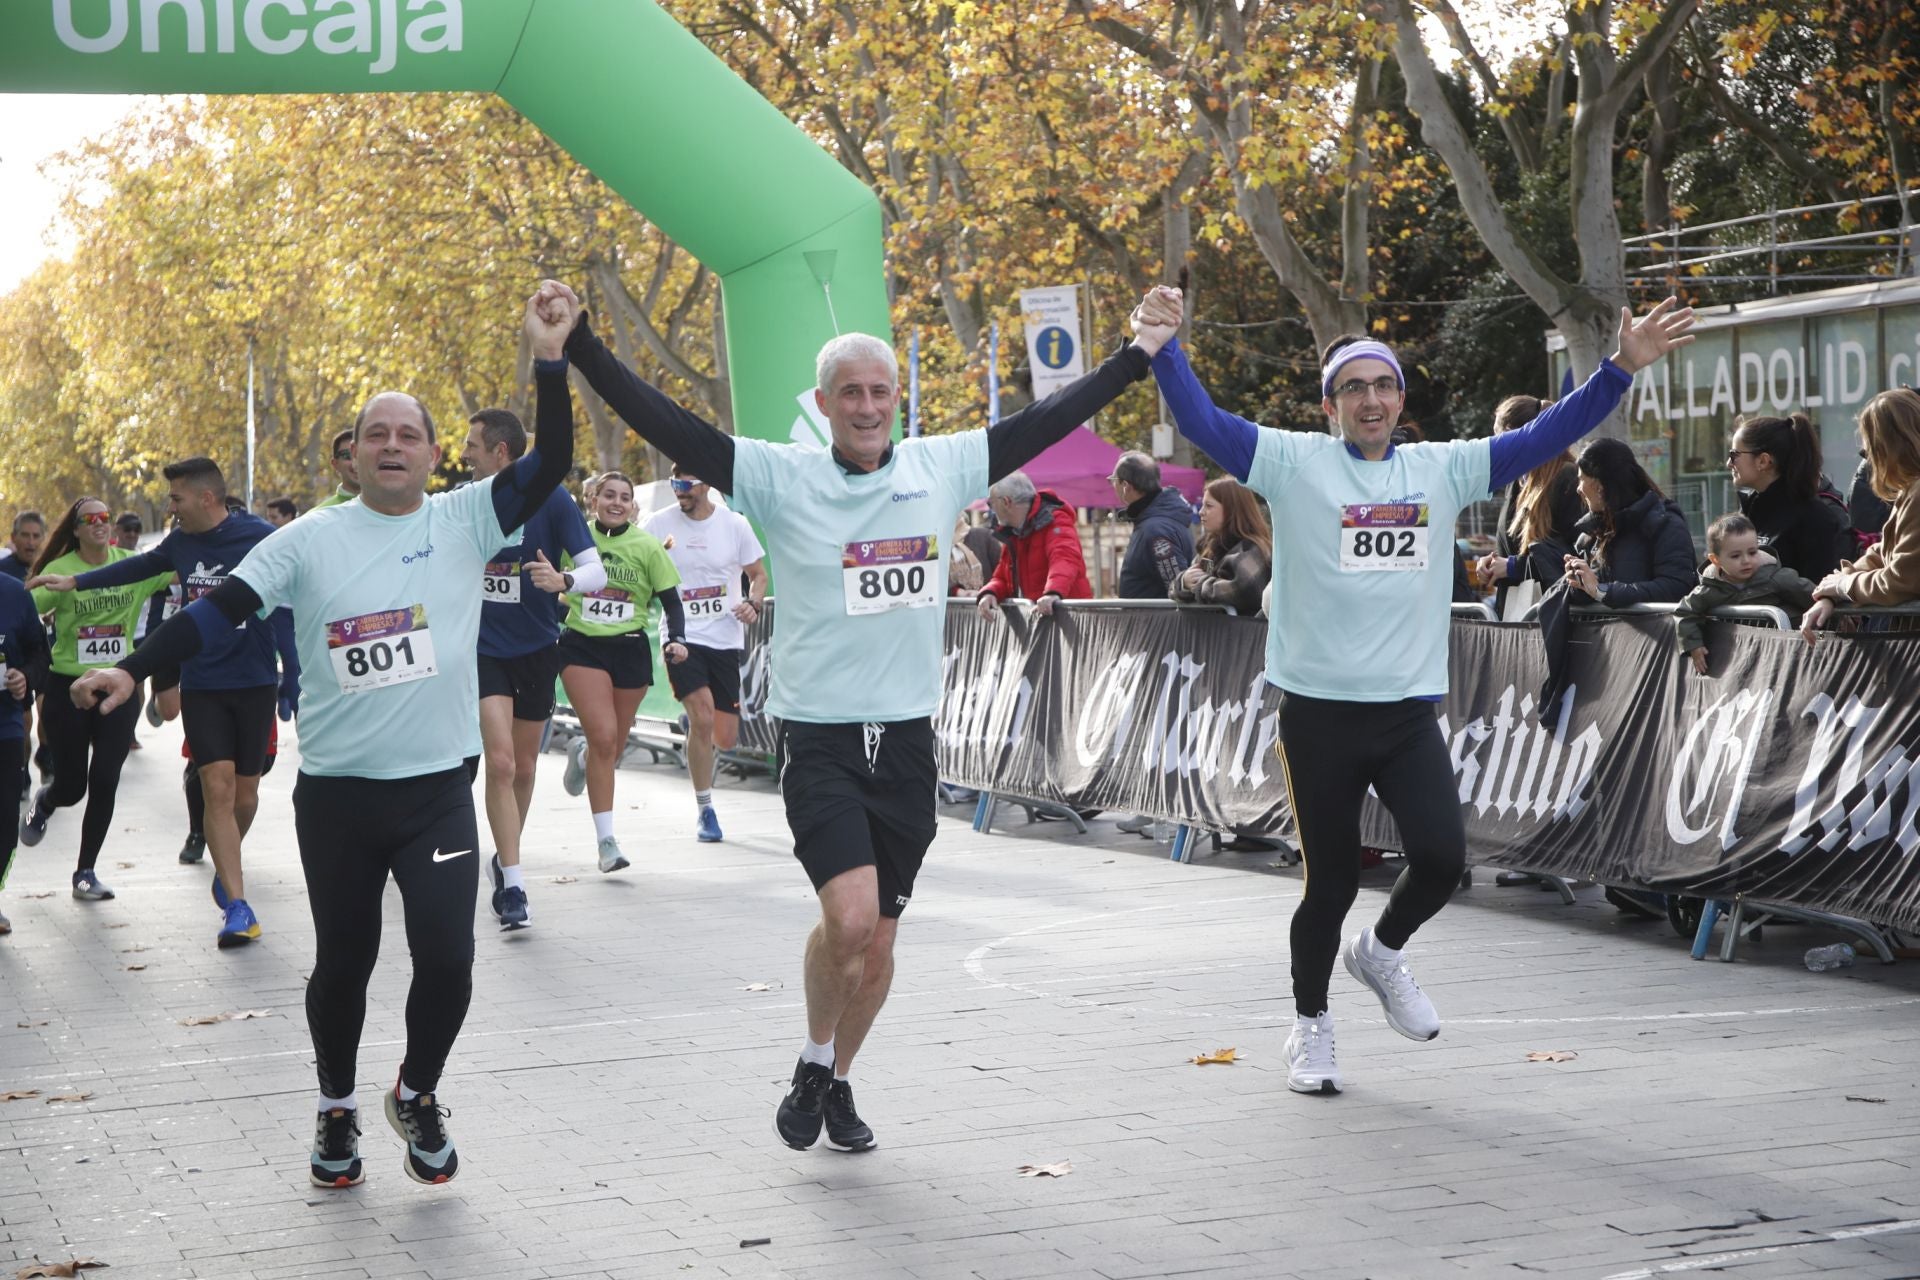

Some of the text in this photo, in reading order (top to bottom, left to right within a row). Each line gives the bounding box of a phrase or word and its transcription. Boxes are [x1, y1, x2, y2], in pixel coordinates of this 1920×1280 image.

[52, 0, 464, 74] Unicaja
[1353, 530, 1416, 557] 802
[859, 566, 925, 599] 800
[589, 601, 624, 618] 441
[689, 599, 722, 615] 916
[86, 640, 121, 655] 440
[345, 636, 415, 677] 801
[1437, 684, 1603, 824] stilla
[1666, 688, 1774, 851] El
